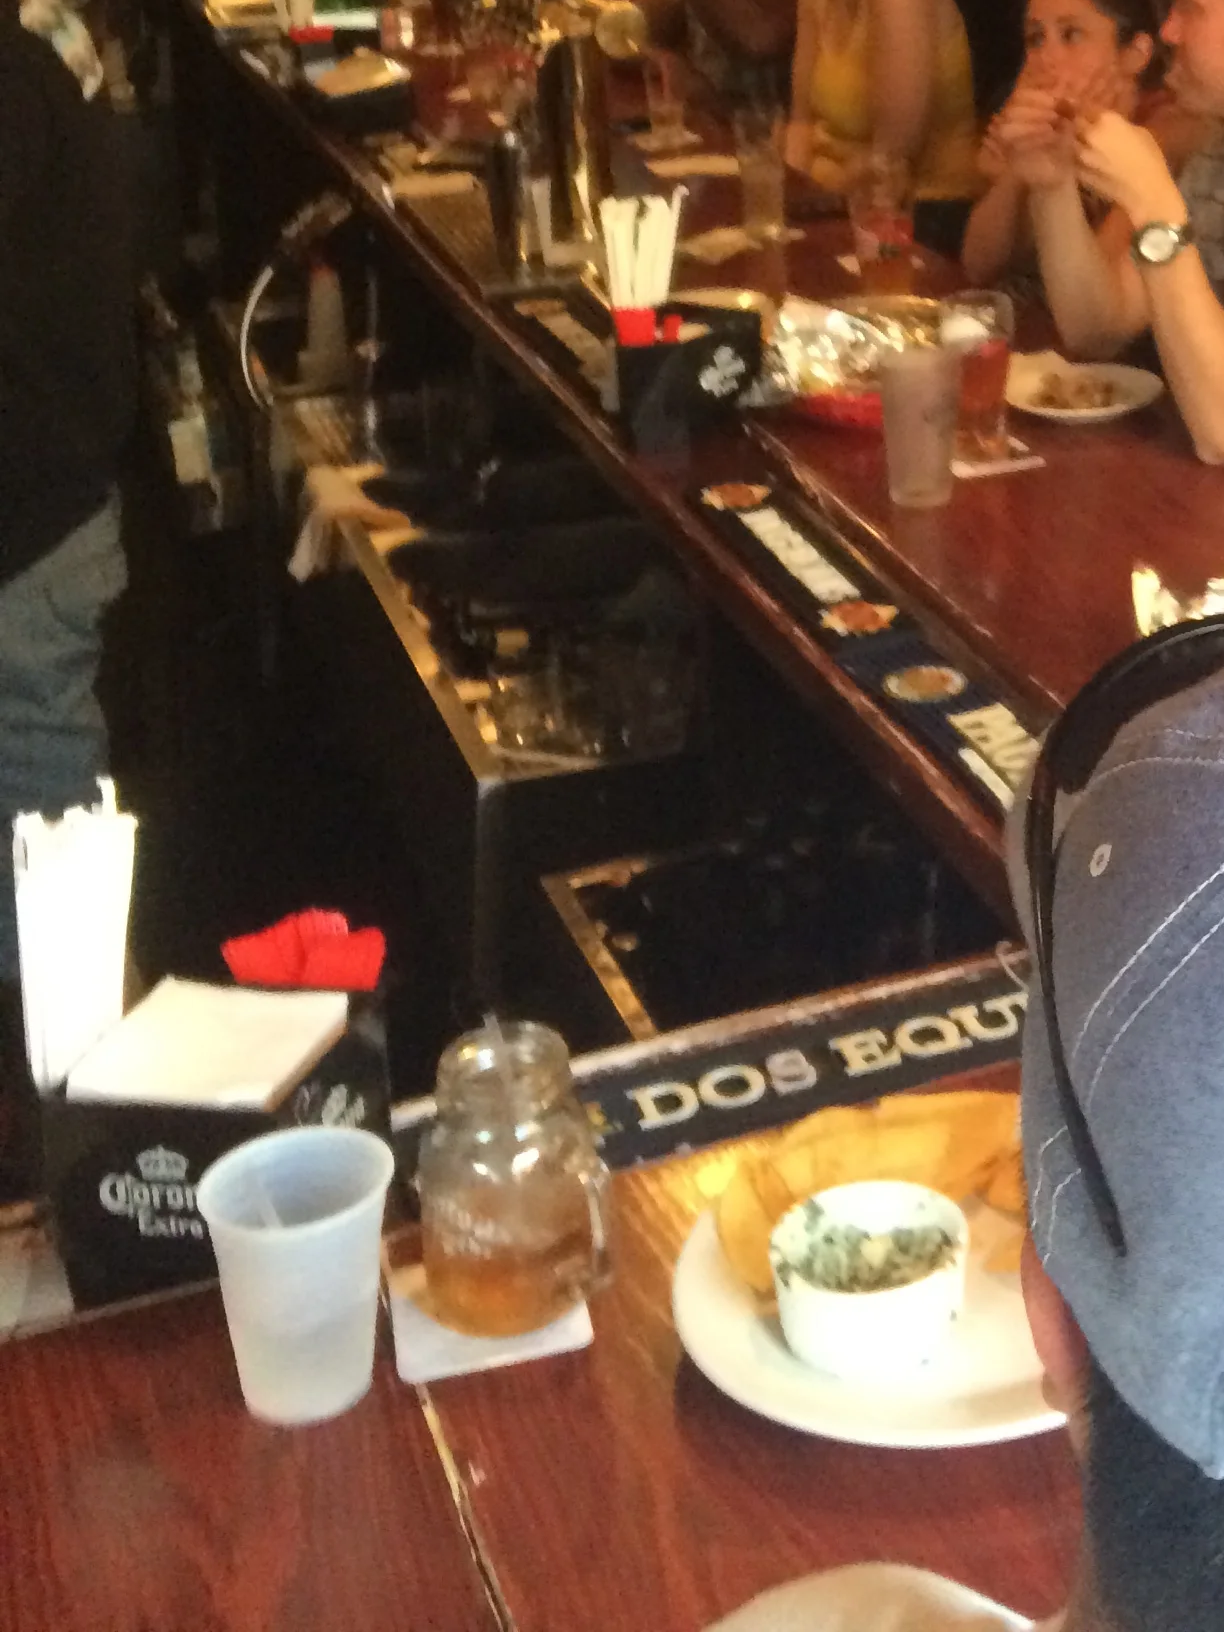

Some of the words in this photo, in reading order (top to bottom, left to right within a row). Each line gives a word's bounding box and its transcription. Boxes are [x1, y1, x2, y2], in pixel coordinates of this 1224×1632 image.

[625, 1050, 818, 1130] DOS
[830, 991, 1028, 1077] EQU
[98, 1171, 198, 1218] Coron
